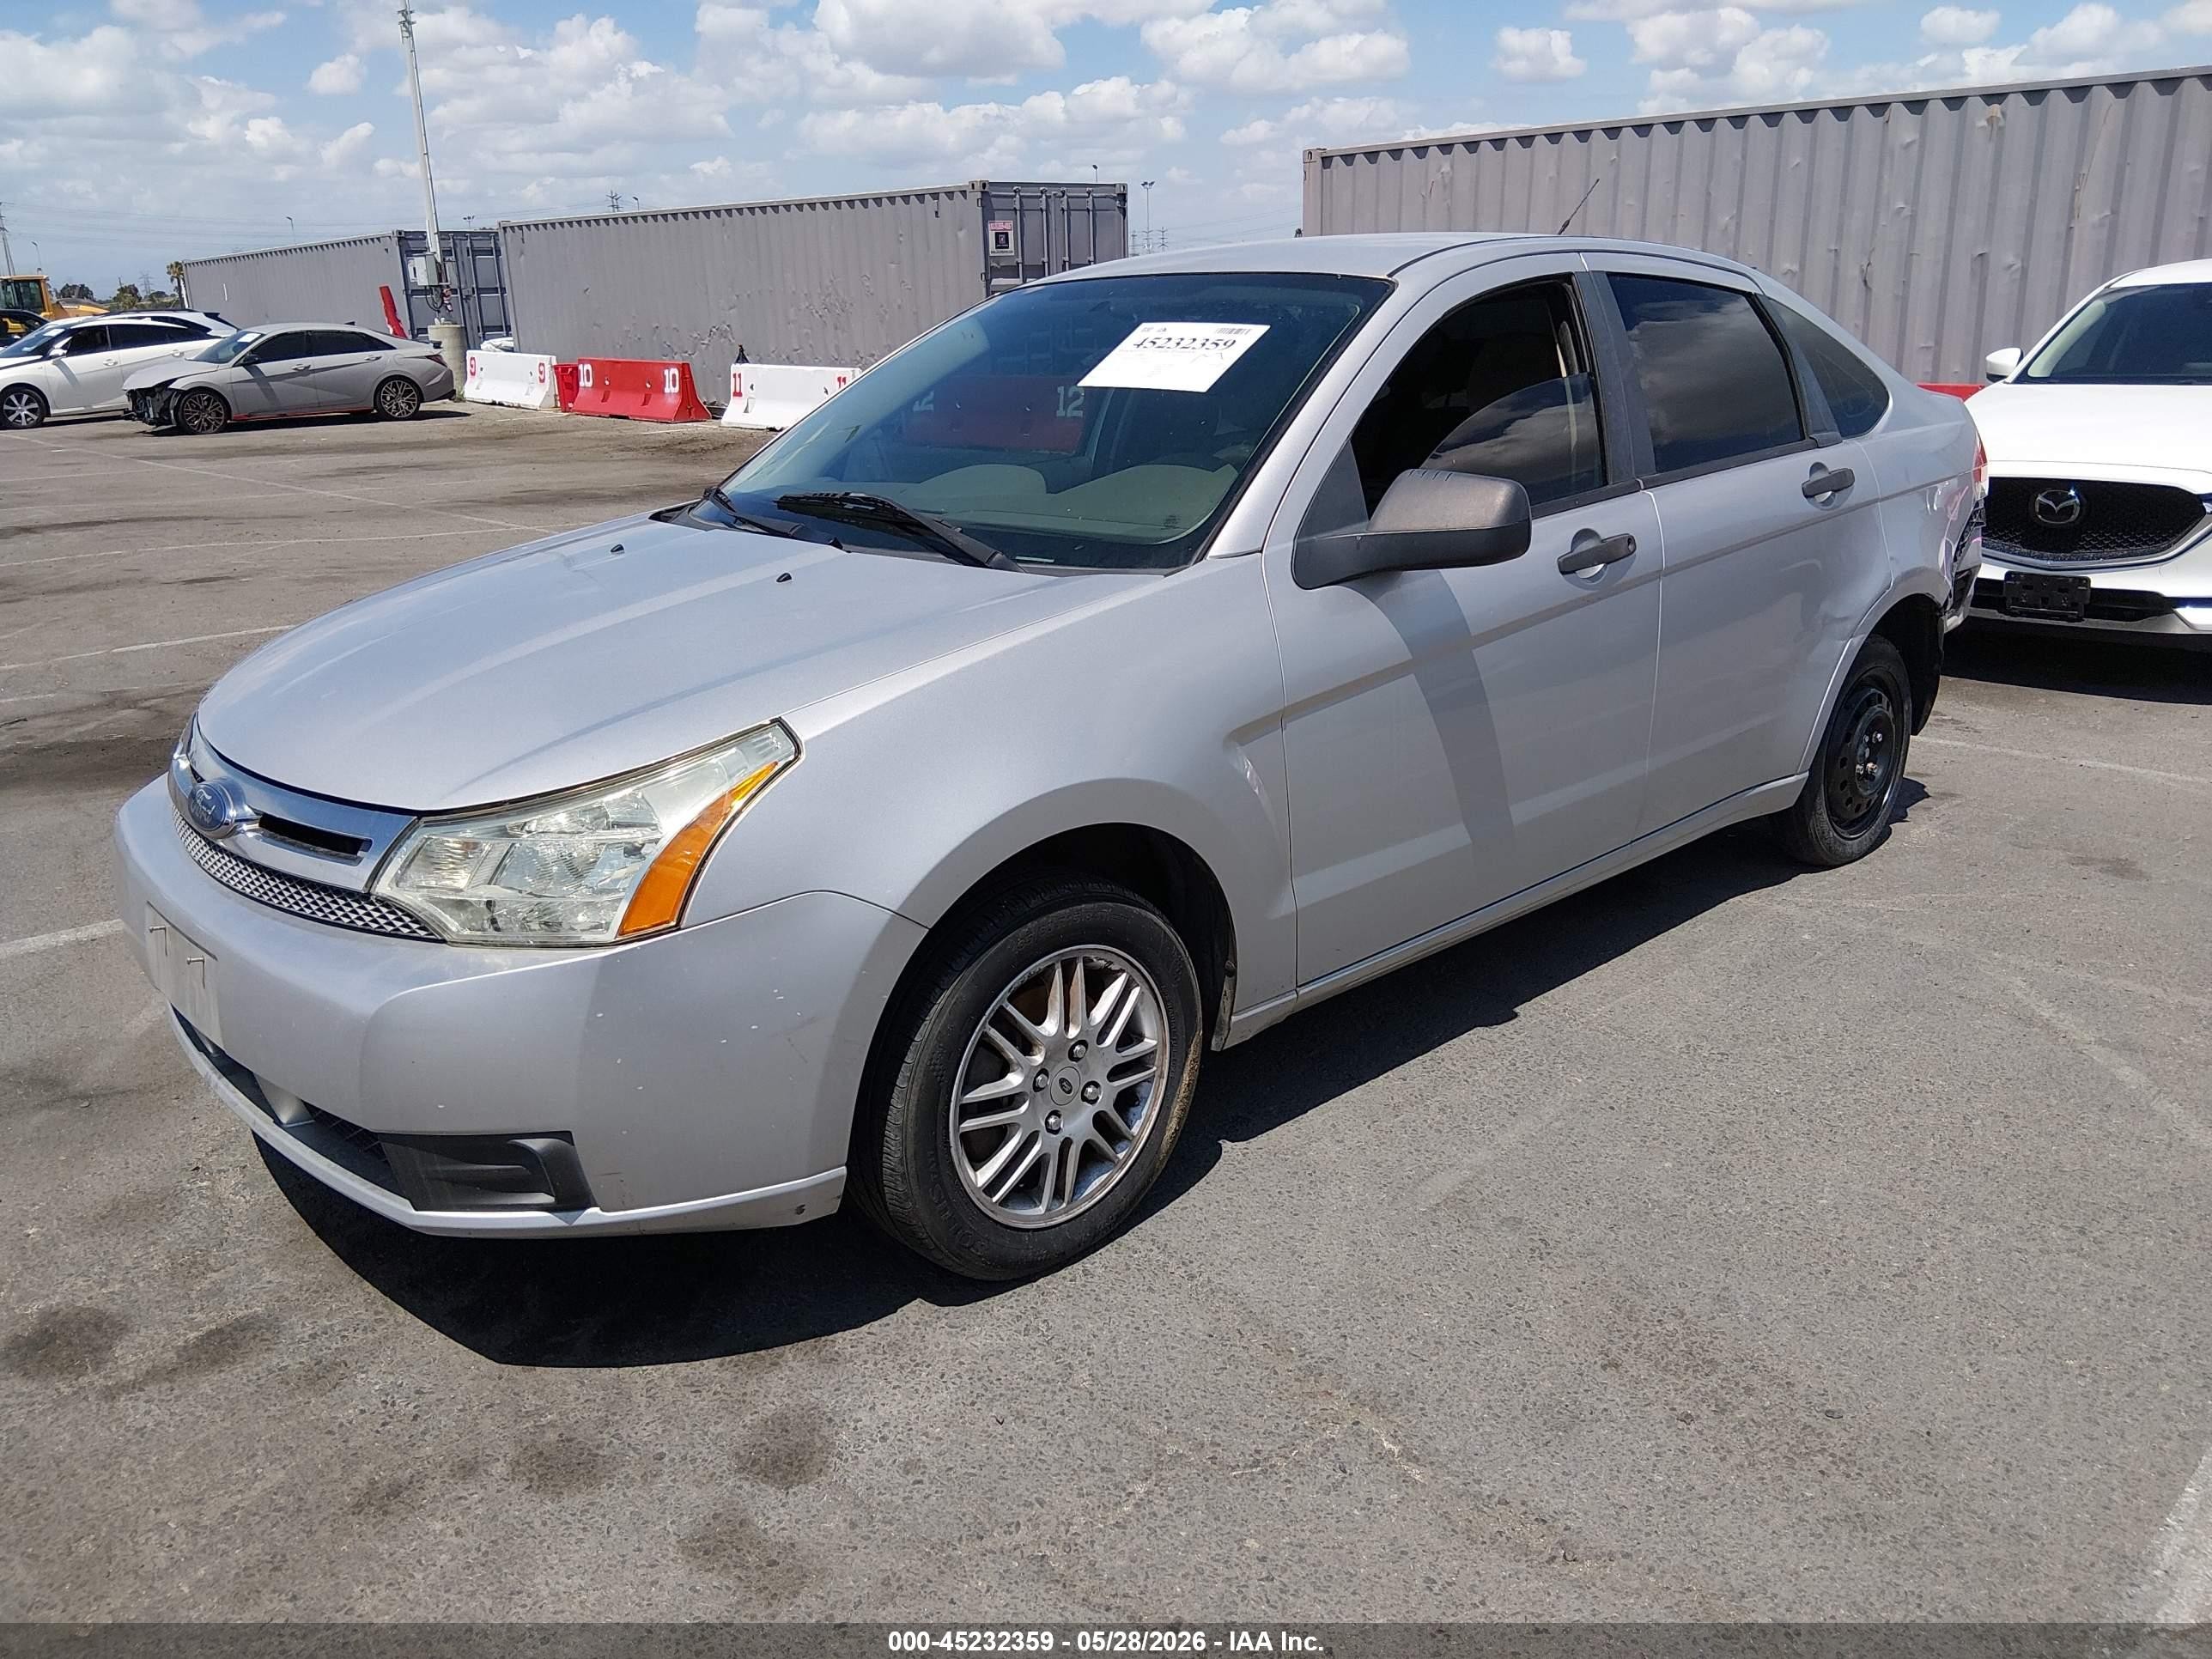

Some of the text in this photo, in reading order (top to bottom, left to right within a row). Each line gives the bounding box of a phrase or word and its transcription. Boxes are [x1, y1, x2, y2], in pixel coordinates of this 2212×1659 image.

[1133, 337, 1237, 350] 45232359
[469, 356, 477, 376] 9
[538, 362, 545, 383] 9
[578, 363, 593, 387] 10
[664, 368, 679, 393] 10
[732, 373, 743, 397] 11
[1056, 386, 1085, 417] 12
